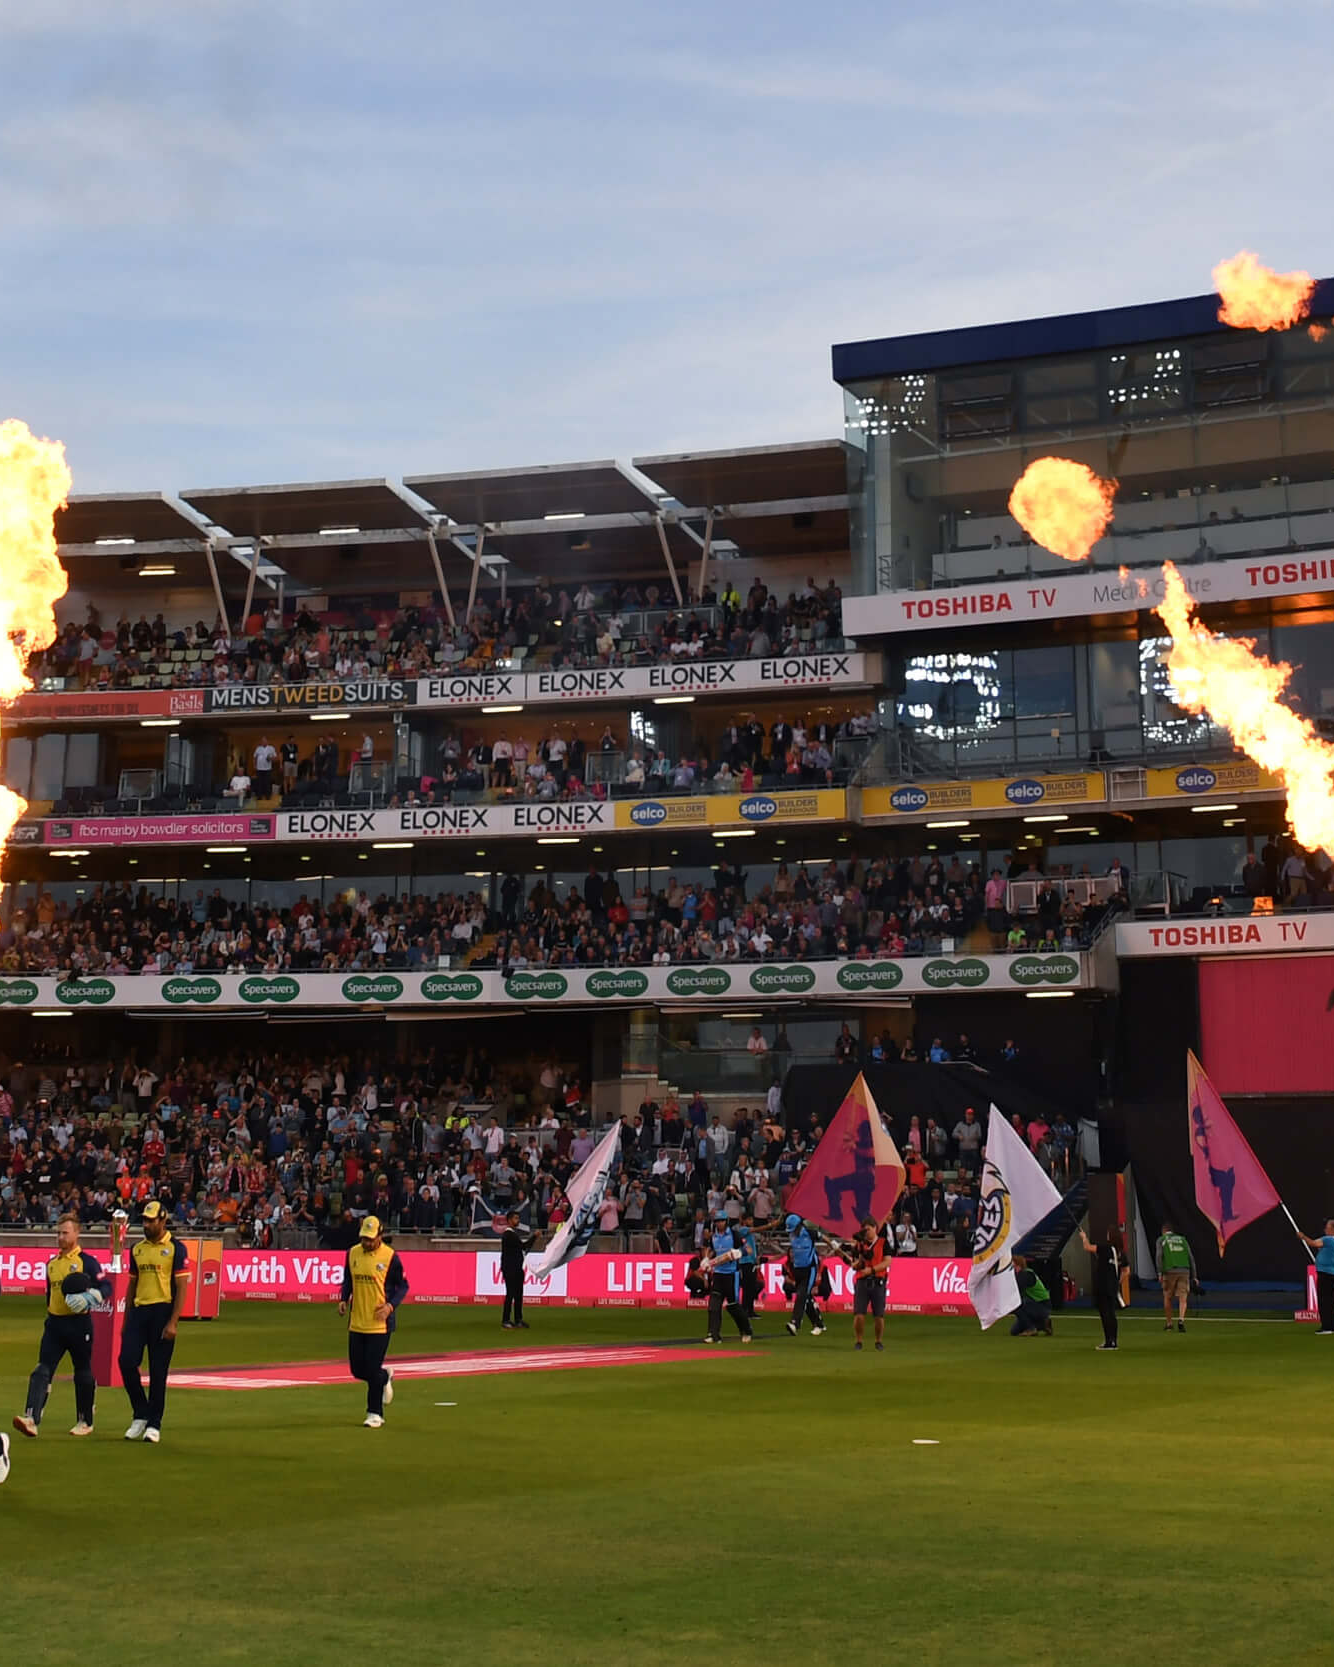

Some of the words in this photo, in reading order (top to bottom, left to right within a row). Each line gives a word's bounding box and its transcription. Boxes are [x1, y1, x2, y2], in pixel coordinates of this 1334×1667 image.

[901, 593, 1013, 619] TOSHIBA
[1027, 588, 1056, 608] TV
[649, 663, 736, 687] ELONEX
[761, 656, 850, 680] ELONEX
[428, 676, 512, 698] ELONEX
[539, 671, 625, 693] ELONEX
[1178, 773, 1214, 787] selco
[1007, 784, 1043, 798] selco
[892, 792, 927, 806] selco
[514, 804, 604, 826] ELONEX
[632, 805, 666, 820] selco
[741, 801, 775, 815] selco
[288, 812, 375, 833] ELONEX
[400, 808, 488, 830] ELONEX
[79, 824, 99, 836] fbc
[100, 824, 139, 838] manby
[141, 822, 188, 835] bowdler
[190, 820, 244, 834] solicitors
[1148, 923, 1262, 947] TOSHIBA
[1277, 921, 1308, 941] TV
[842, 969, 897, 984] Specsavers
[927, 965, 984, 981] Specsavers
[1014, 962, 1073, 979] Specsavers
[510, 979, 562, 992] Specsavers
[591, 976, 643, 991] Specsavers
[672, 974, 725, 989] Specsavers
[756, 972, 810, 986] Specsavers
[60, 986, 110, 998] Specsavers
[167, 983, 216, 996] Specsavers
[244, 982, 295, 995] Specsavers
[347, 982, 398, 995] Specsavers
[426, 980, 477, 994] Specsavers
[226, 1255, 285, 1284] with
[606, 1262, 674, 1292] LIFE
